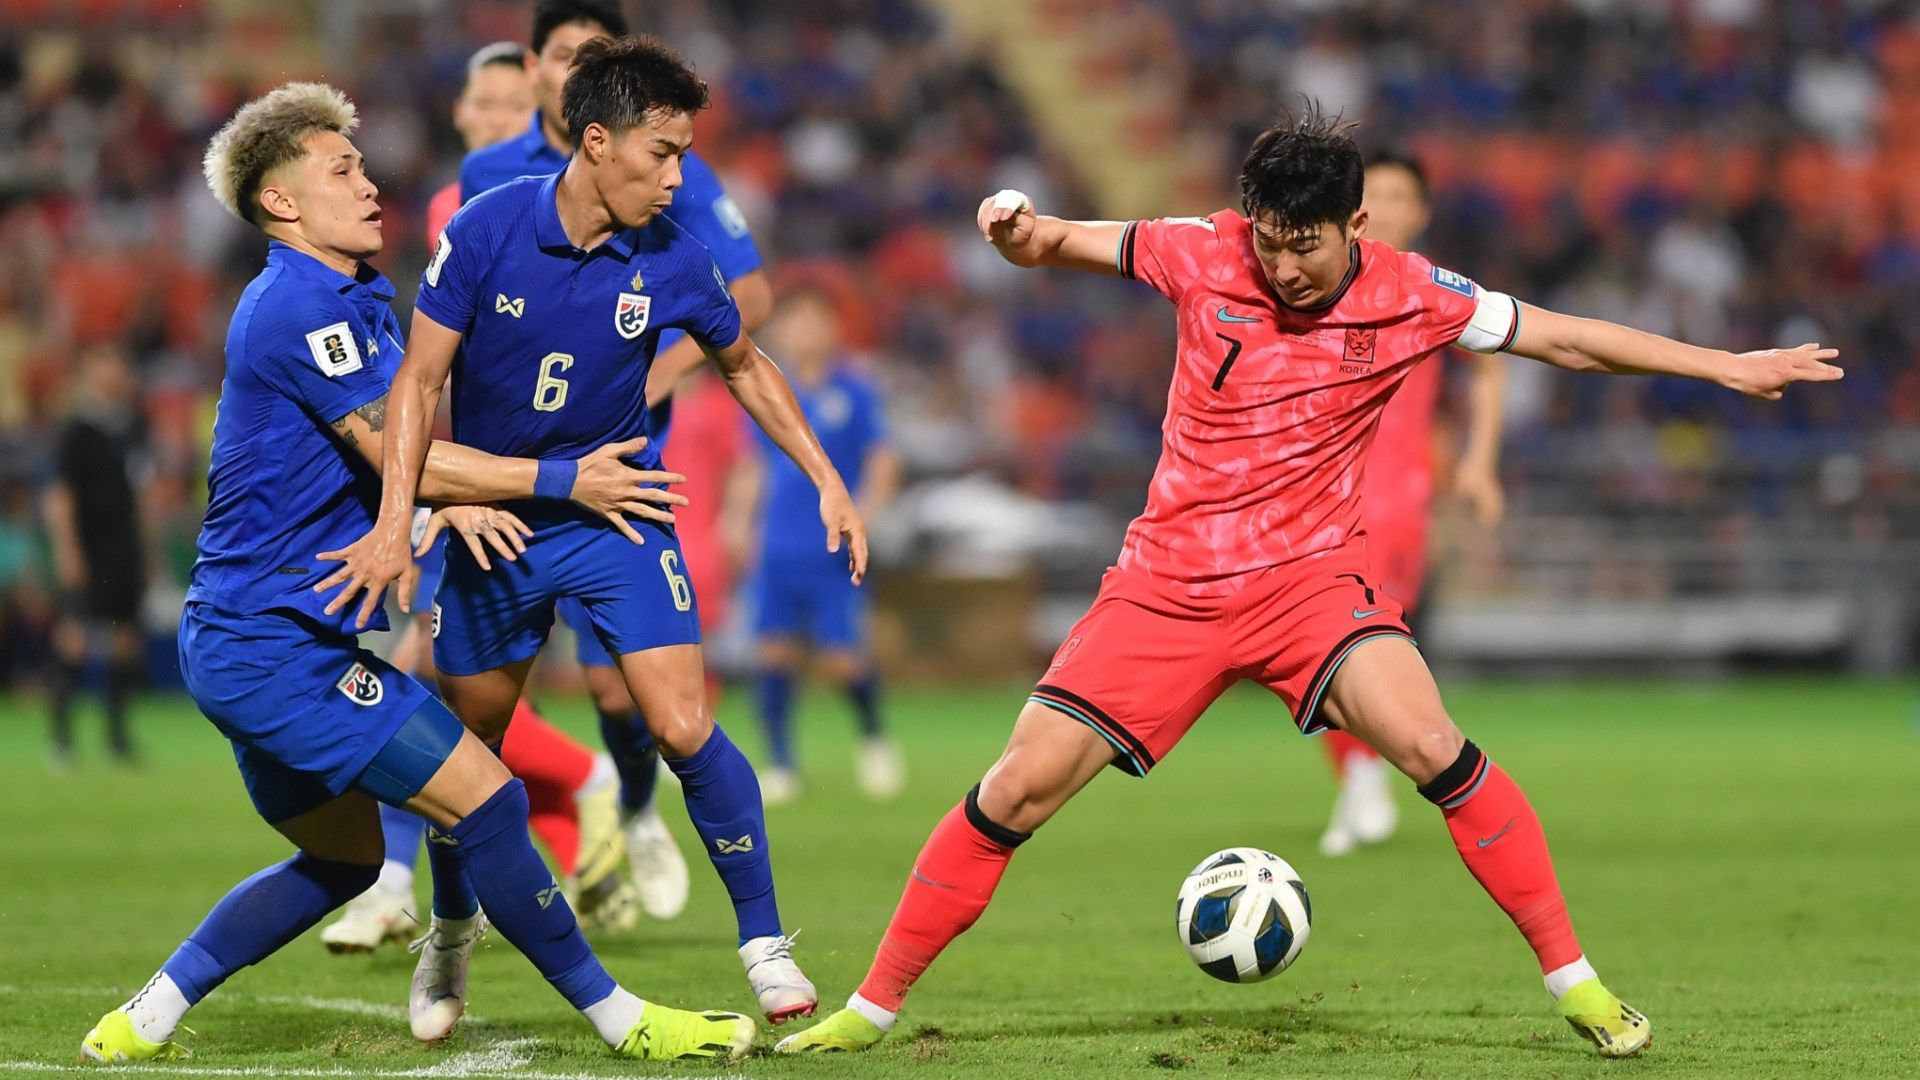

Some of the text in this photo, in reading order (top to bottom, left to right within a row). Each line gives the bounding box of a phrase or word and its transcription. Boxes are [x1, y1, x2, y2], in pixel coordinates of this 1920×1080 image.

[533, 352, 574, 412] 6
[1211, 331, 1242, 392] 7
[1339, 364, 1372, 375] KOREA
[660, 549, 691, 612] 6
[1335, 574, 1375, 605] 7
[1194, 868, 1243, 891] molten
